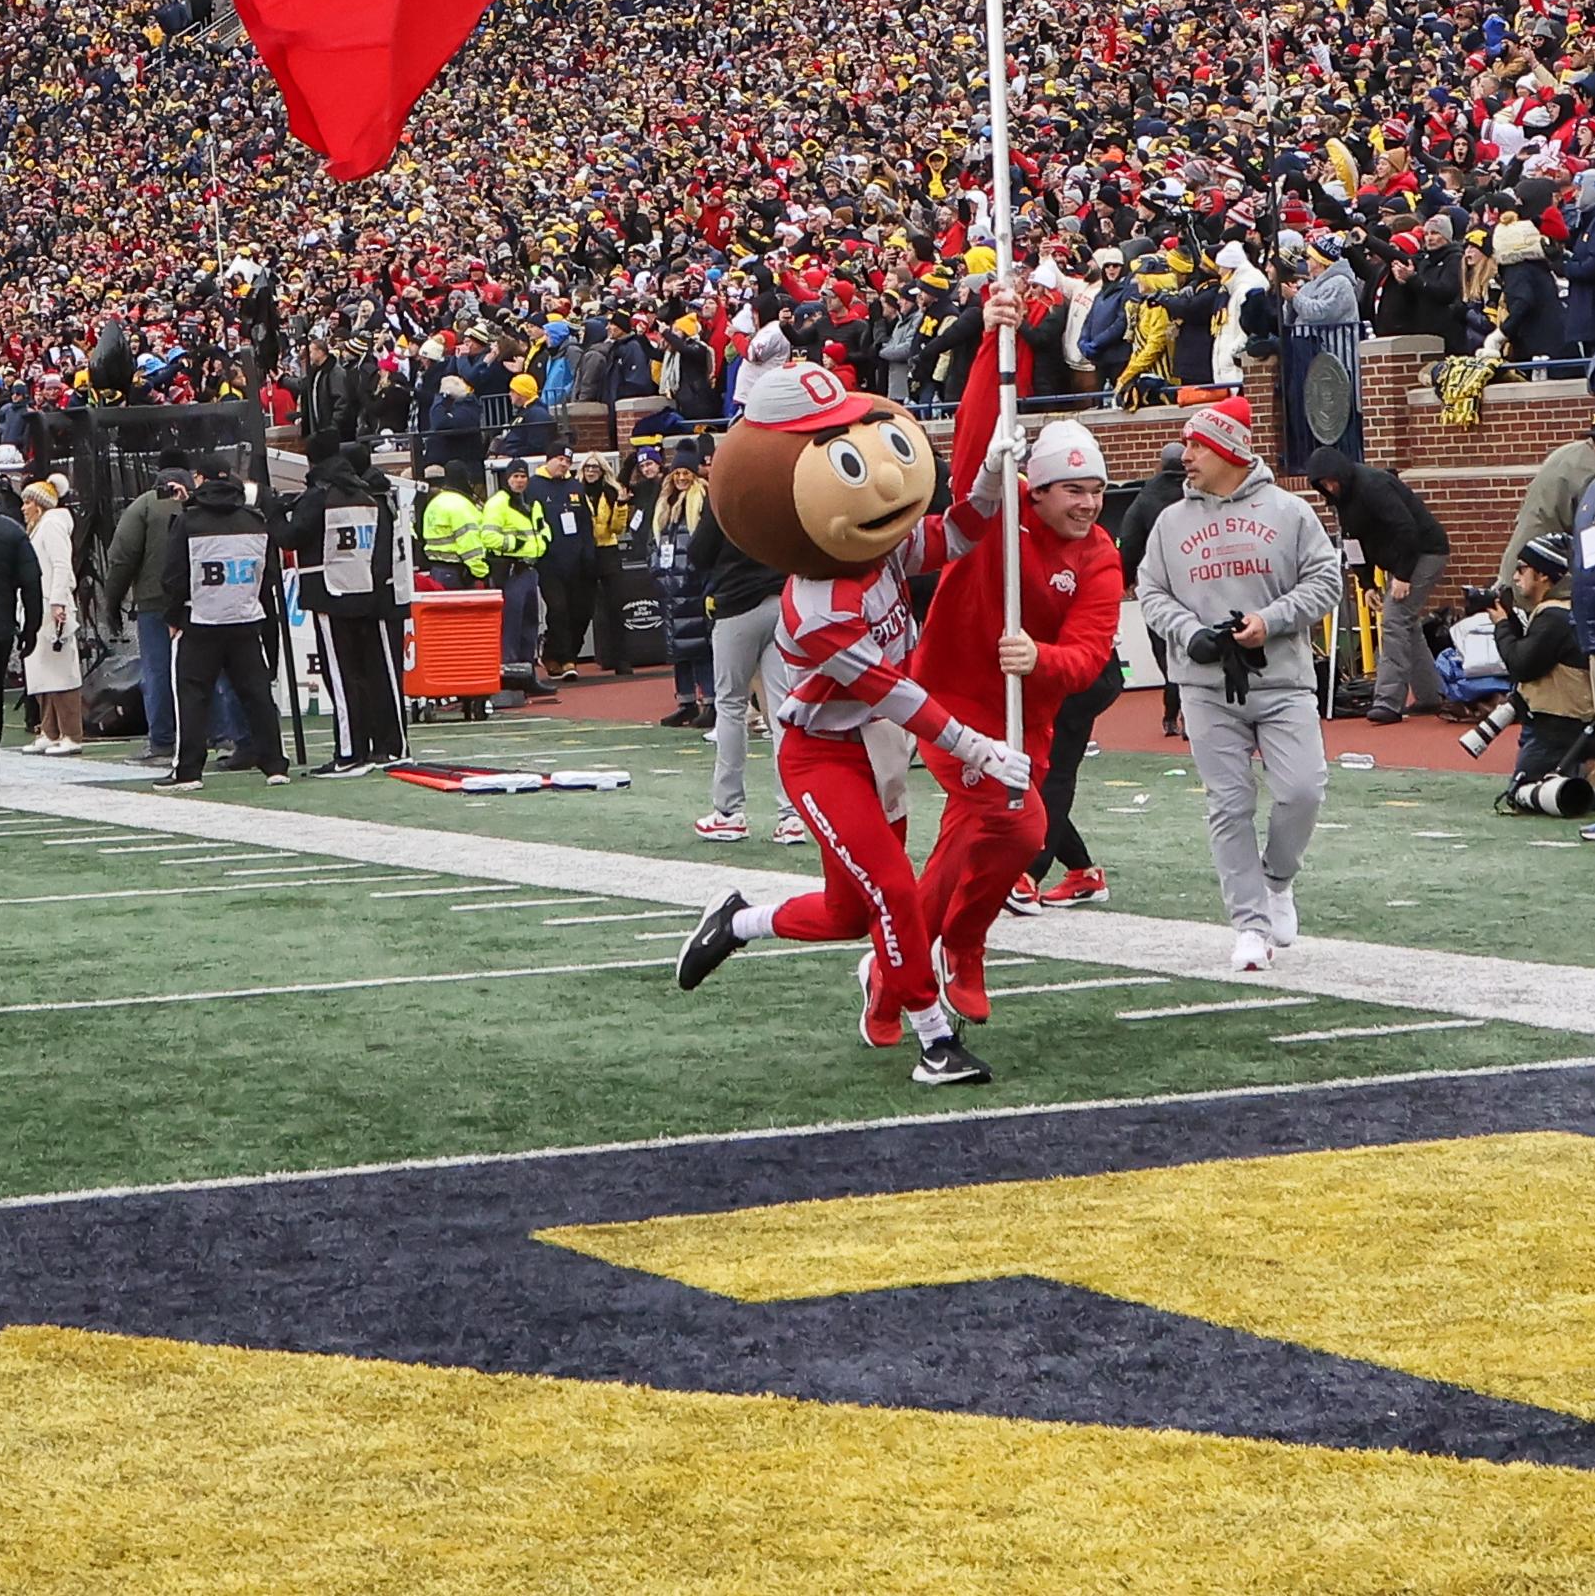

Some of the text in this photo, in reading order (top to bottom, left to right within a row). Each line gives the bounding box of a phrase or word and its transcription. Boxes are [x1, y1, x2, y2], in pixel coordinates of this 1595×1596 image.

[800, 371, 837, 405] O
[1198, 411, 1235, 434] STATE
[1180, 523, 1220, 555] OHIO
[1225, 517, 1278, 544] STATE
[1189, 558, 1273, 584] FOOTBALL
